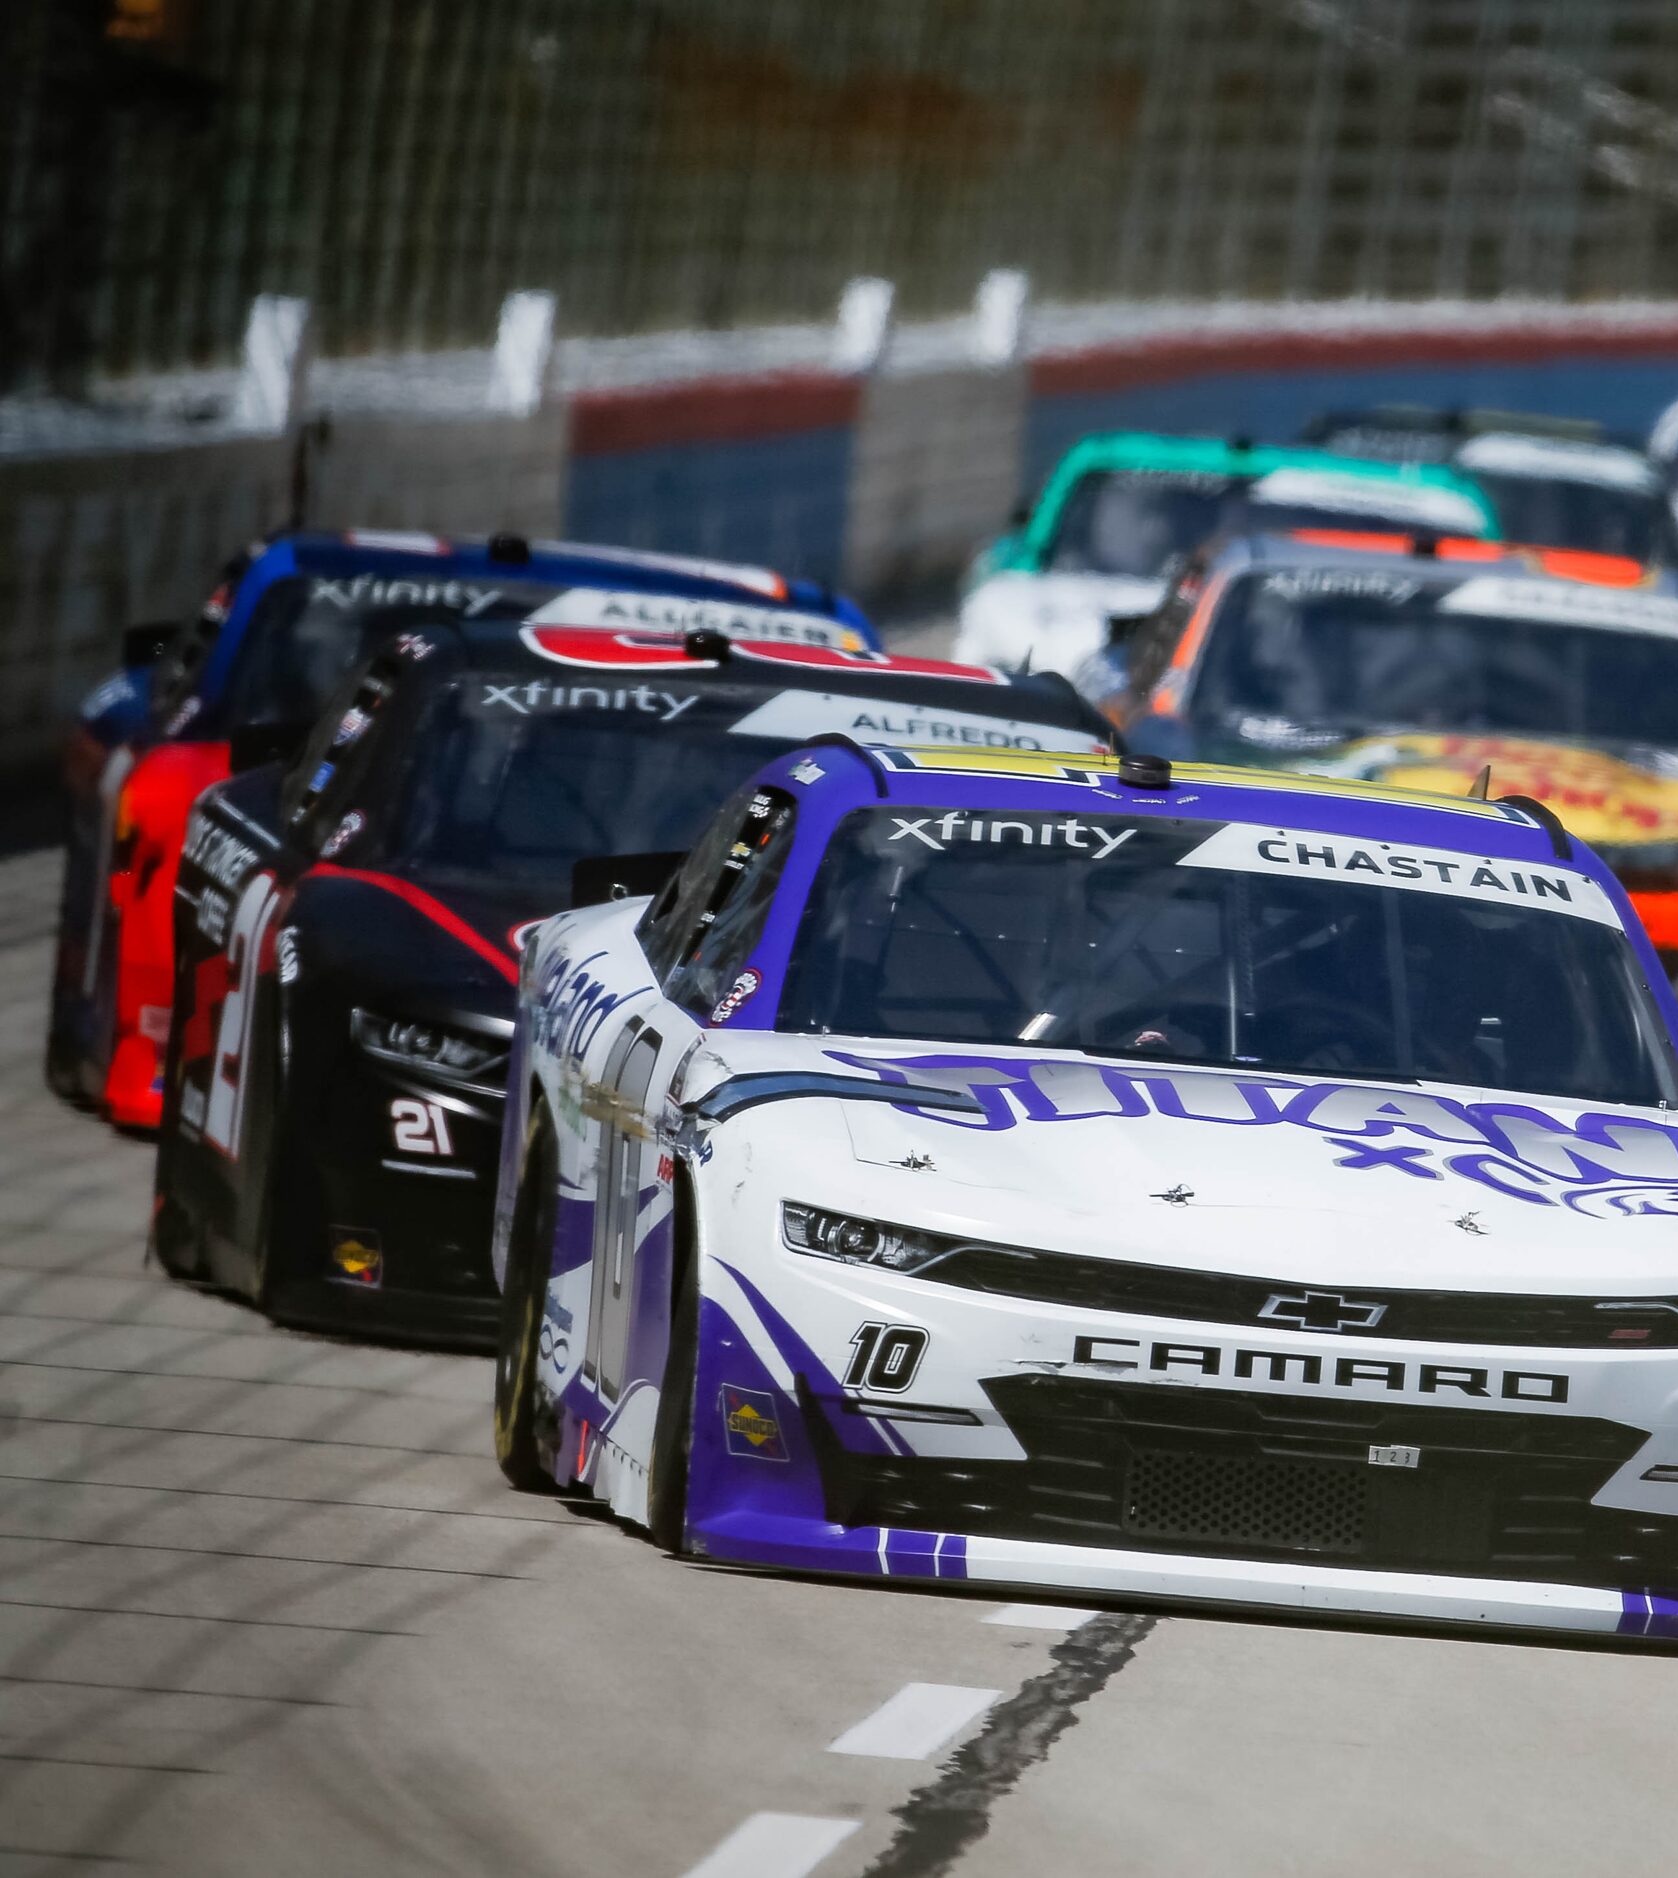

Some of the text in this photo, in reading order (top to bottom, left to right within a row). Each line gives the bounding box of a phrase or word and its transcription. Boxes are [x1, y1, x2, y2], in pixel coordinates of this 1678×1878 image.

[310, 573, 503, 617] xfinity
[481, 681, 699, 721] xfinity
[852, 712, 1043, 750] ALFREDO
[888, 811, 1138, 859] xfinity
[1257, 839, 1573, 903] CHASTAIN
[389, 1099, 453, 1156] 21
[842, 1321, 931, 1394] 10
[1073, 1335, 1570, 1404] CAMARO
[731, 1414, 776, 1438] SUNOCO
